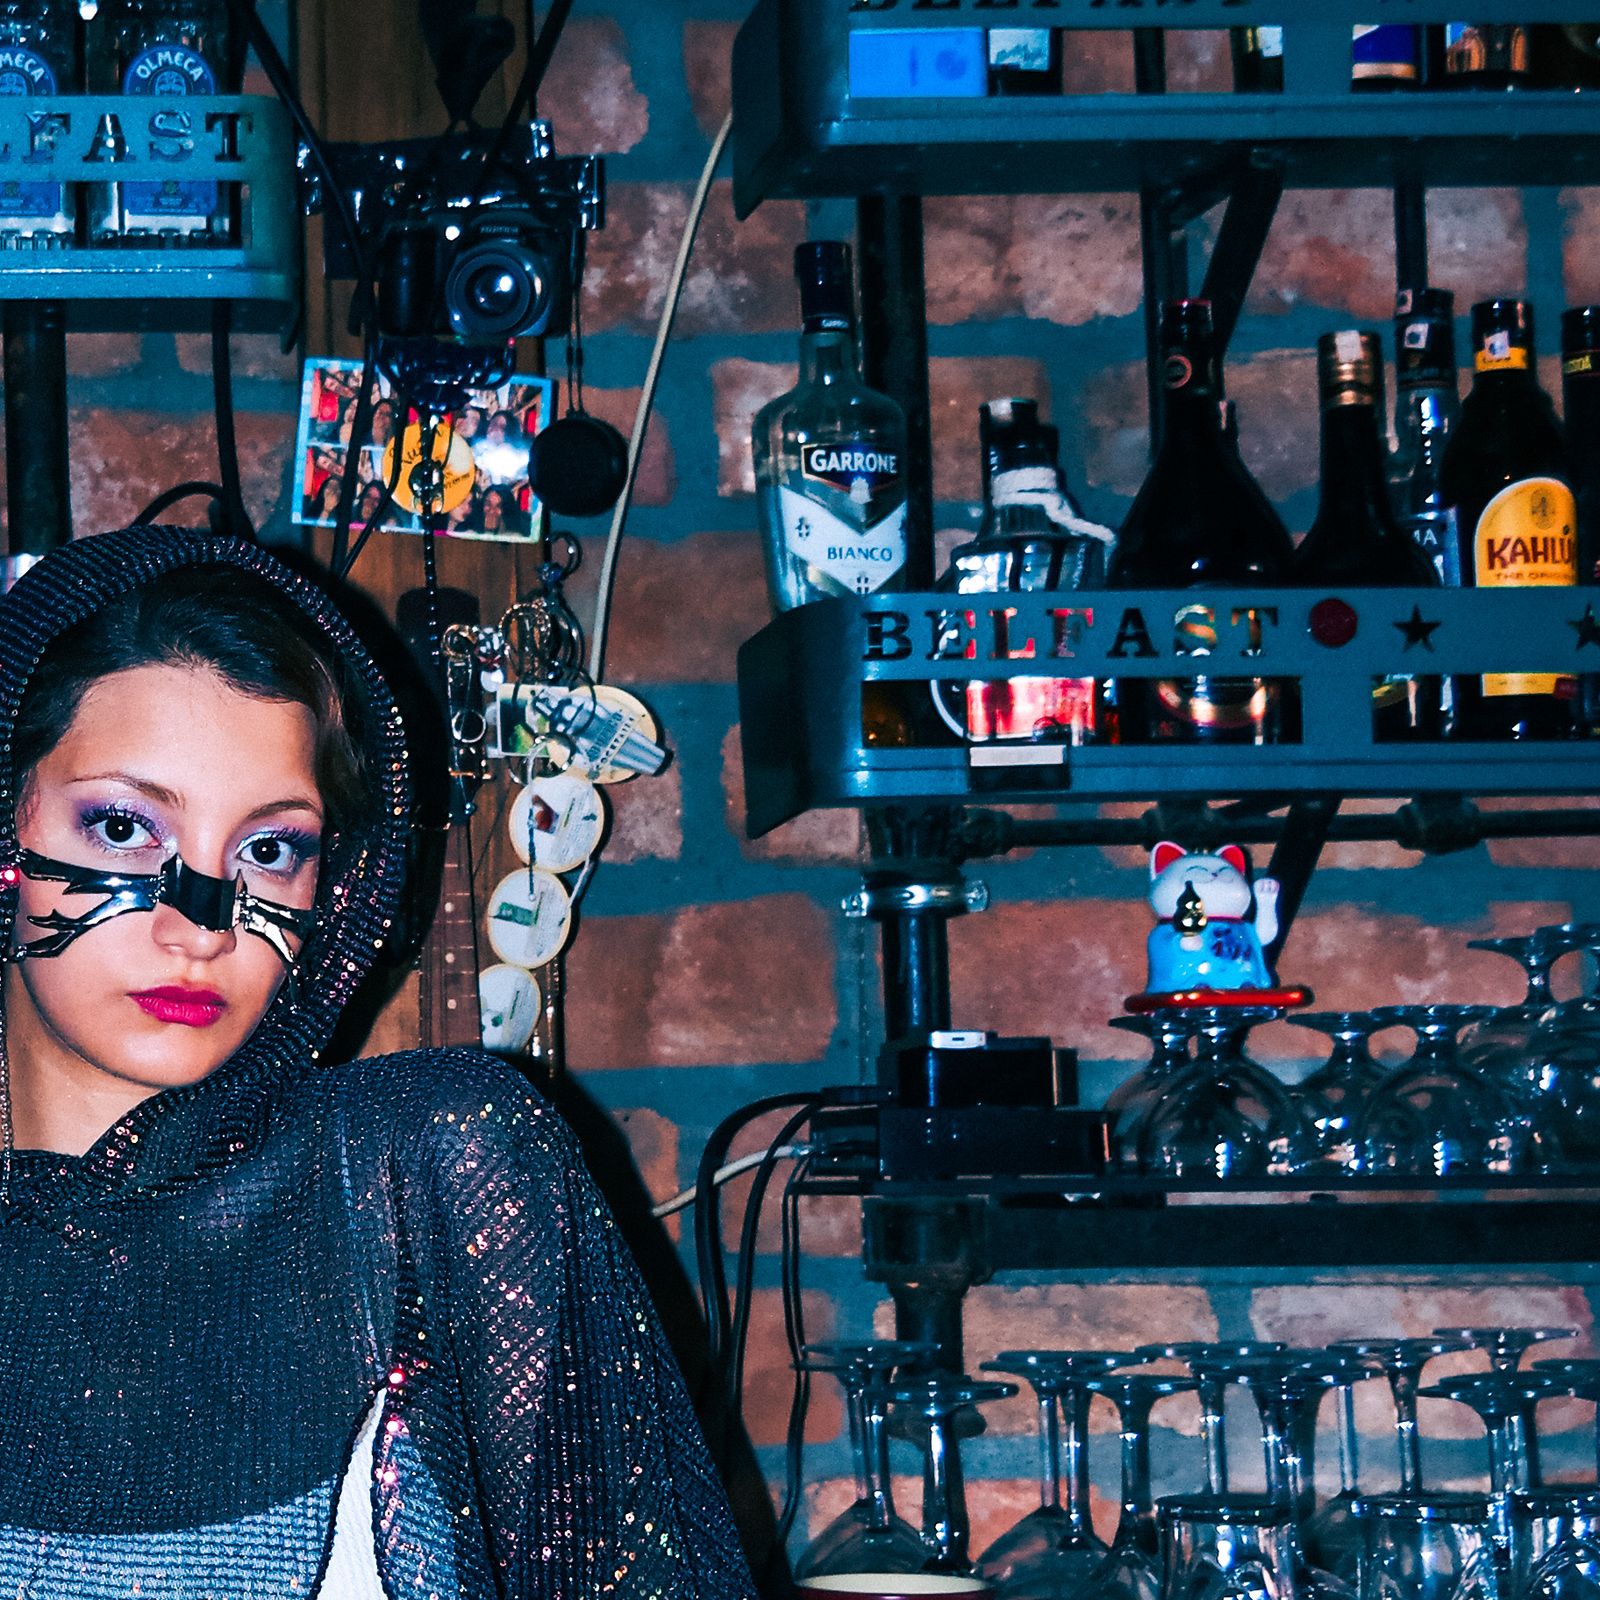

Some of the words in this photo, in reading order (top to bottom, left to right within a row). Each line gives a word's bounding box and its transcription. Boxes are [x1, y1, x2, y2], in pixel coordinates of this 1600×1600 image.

[136, 50, 205, 82] OLMECA
[810, 449, 898, 475] GARRONE
[827, 546, 893, 563] BIANCO
[1486, 524, 1577, 570] KAHLÚ
[862, 605, 1279, 662] BELFAST
